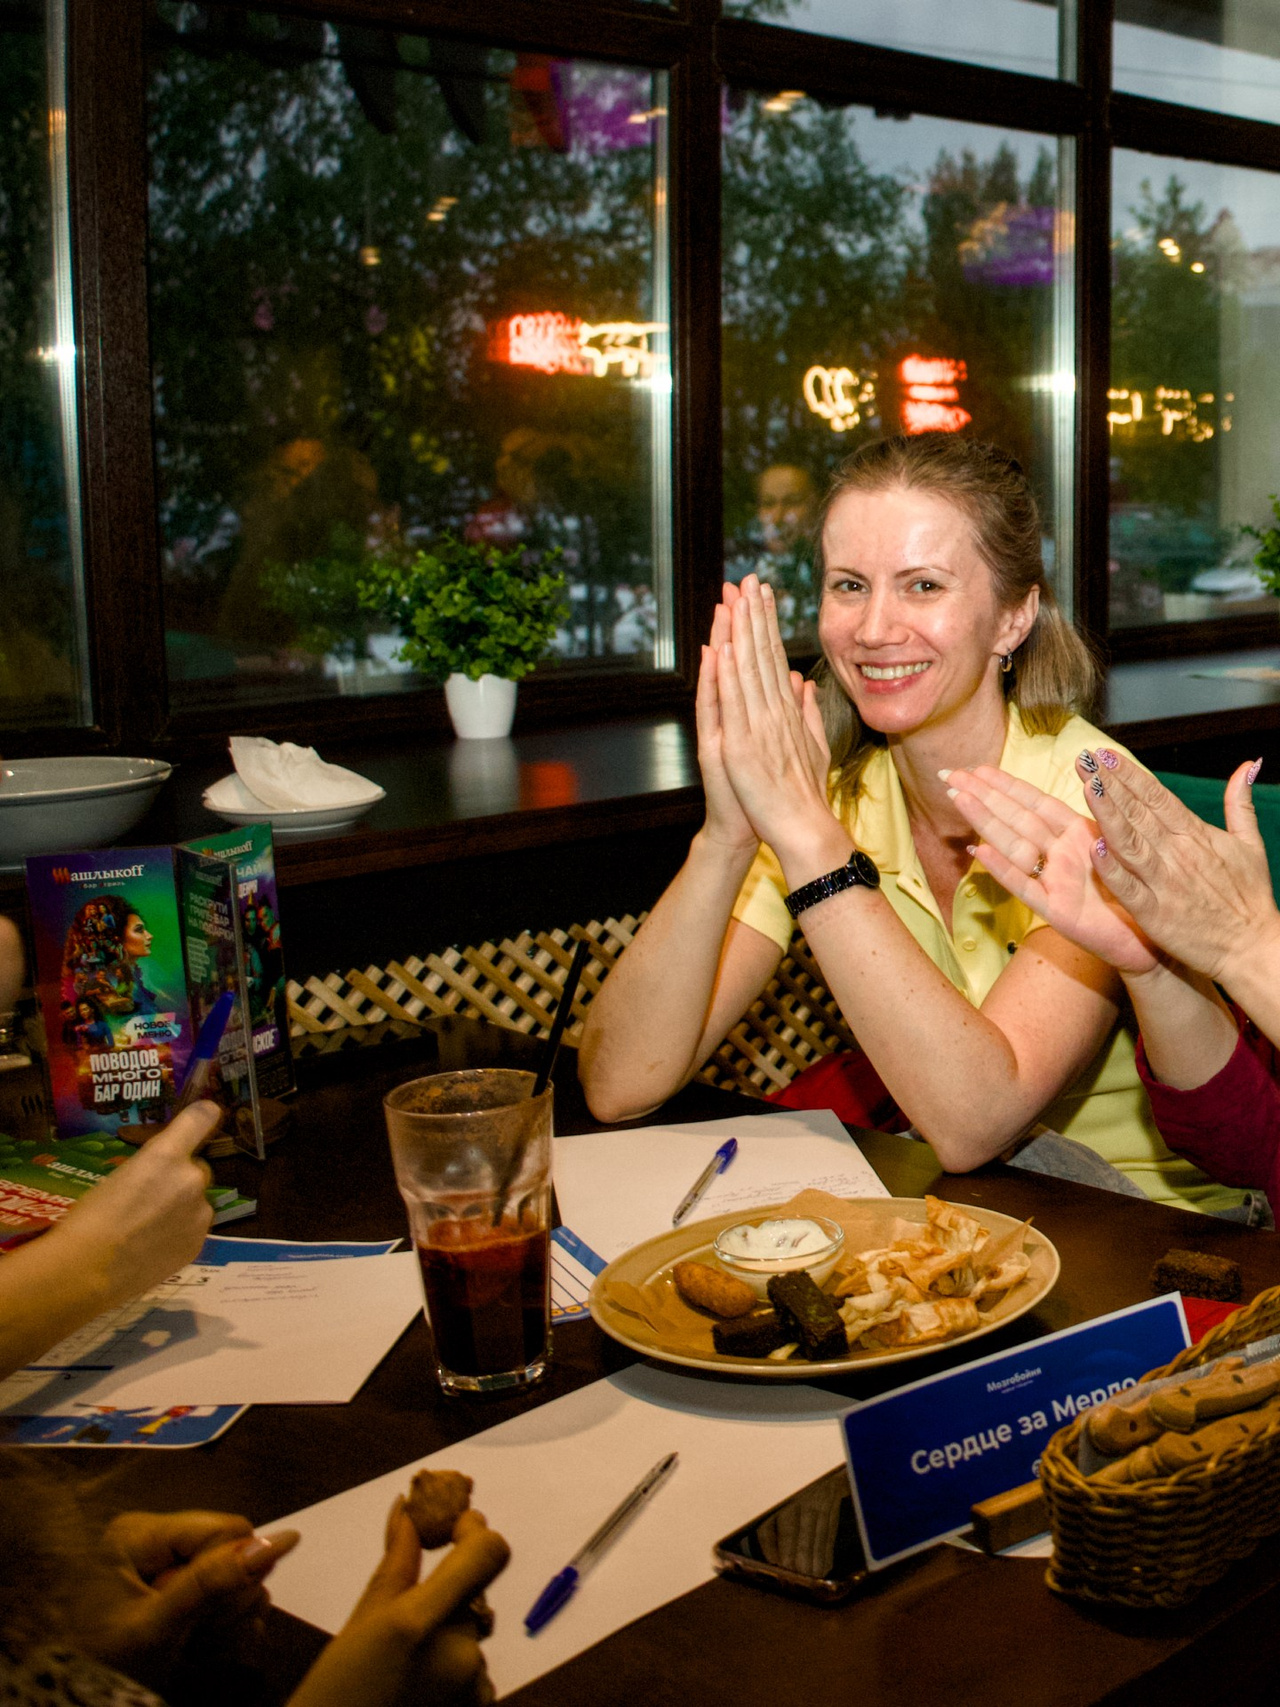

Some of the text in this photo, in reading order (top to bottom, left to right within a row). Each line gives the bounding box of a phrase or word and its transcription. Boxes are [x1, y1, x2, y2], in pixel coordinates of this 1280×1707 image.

[134, 1021, 171, 1031] НОВОЕ
[137, 1029, 172, 1039] МЕНЮ
[90, 1049, 160, 1073] ПОВОДОВ
[92, 1068, 162, 1084] МНОГО
[94, 1079, 161, 1103] БАР ОДИН
[986, 1366, 1043, 1394] Мозгобойня
[910, 1422, 1013, 1475] Сердце
[1017, 1410, 1049, 1436] за
